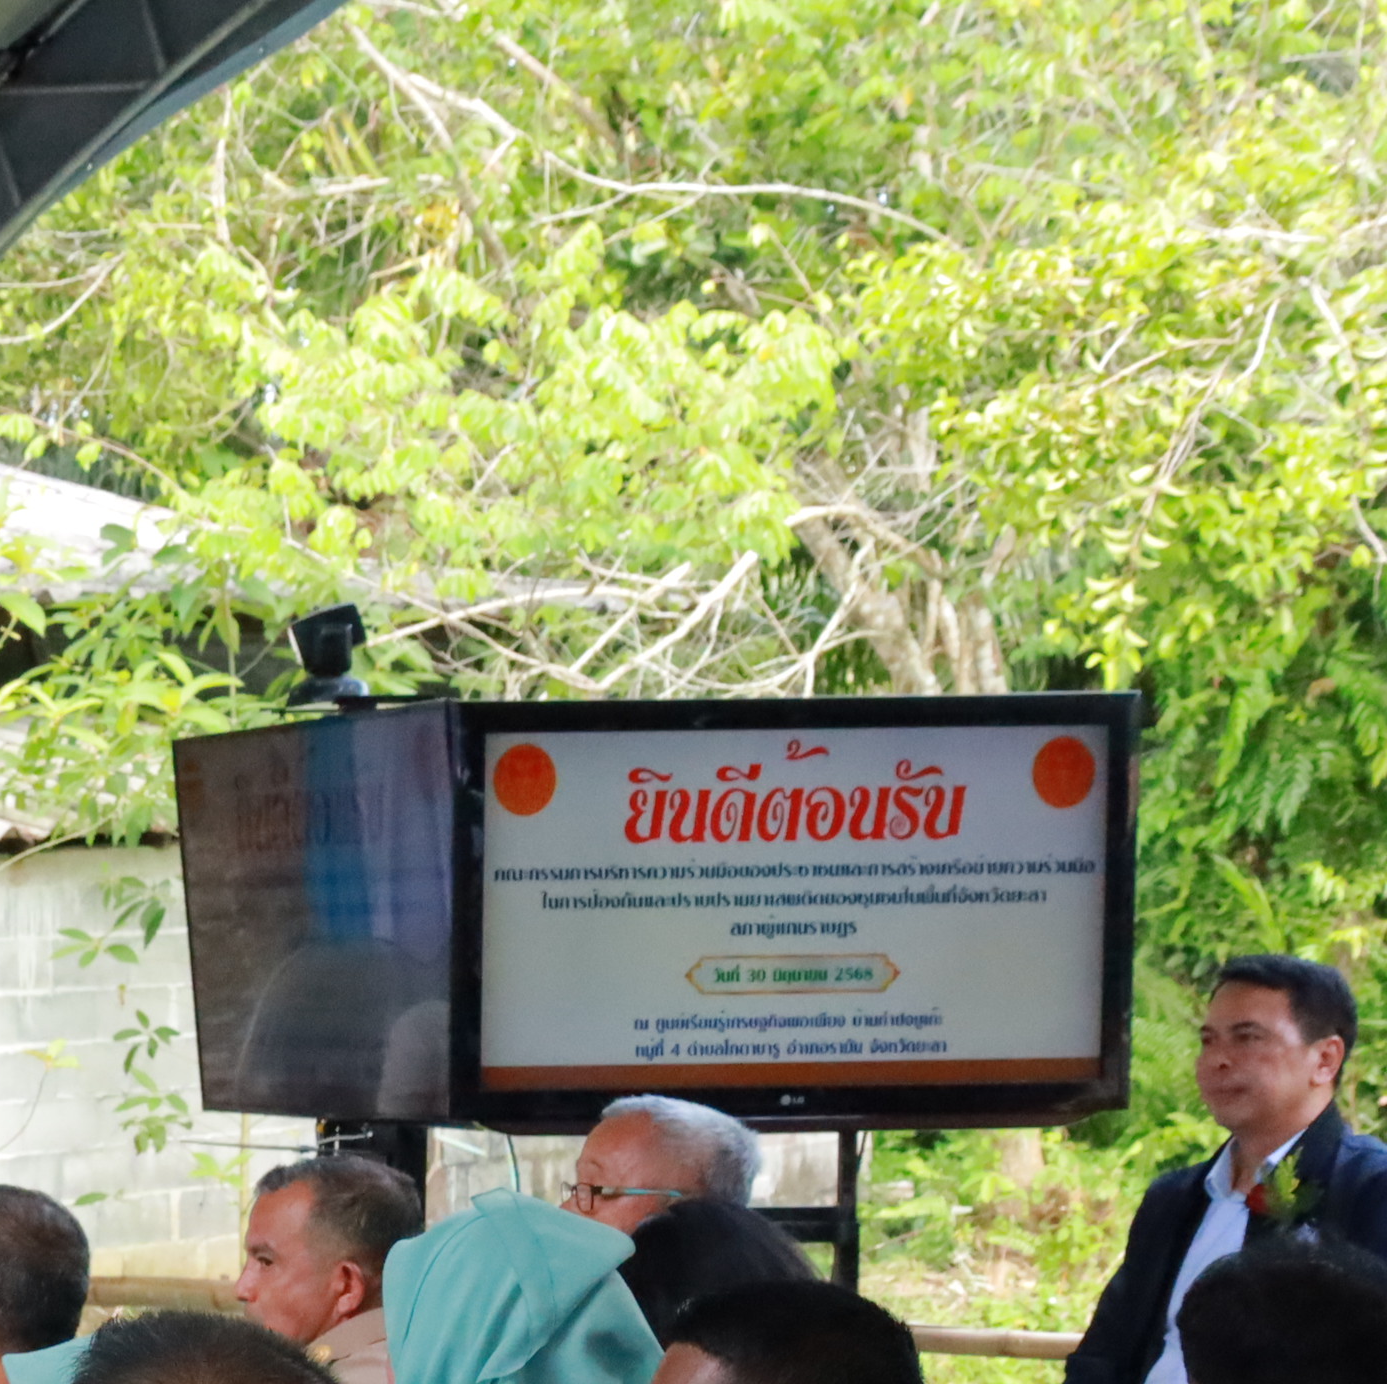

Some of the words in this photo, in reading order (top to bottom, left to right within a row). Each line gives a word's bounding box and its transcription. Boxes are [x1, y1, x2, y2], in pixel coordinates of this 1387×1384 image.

[624, 739, 966, 843] ยินดีต้อนรับ
[730, 914, 857, 938] สภาผู้แทนราษฎร
[748, 968, 767, 982] 30
[834, 967, 874, 982] 2568
[671, 1044, 681, 1057] 4
